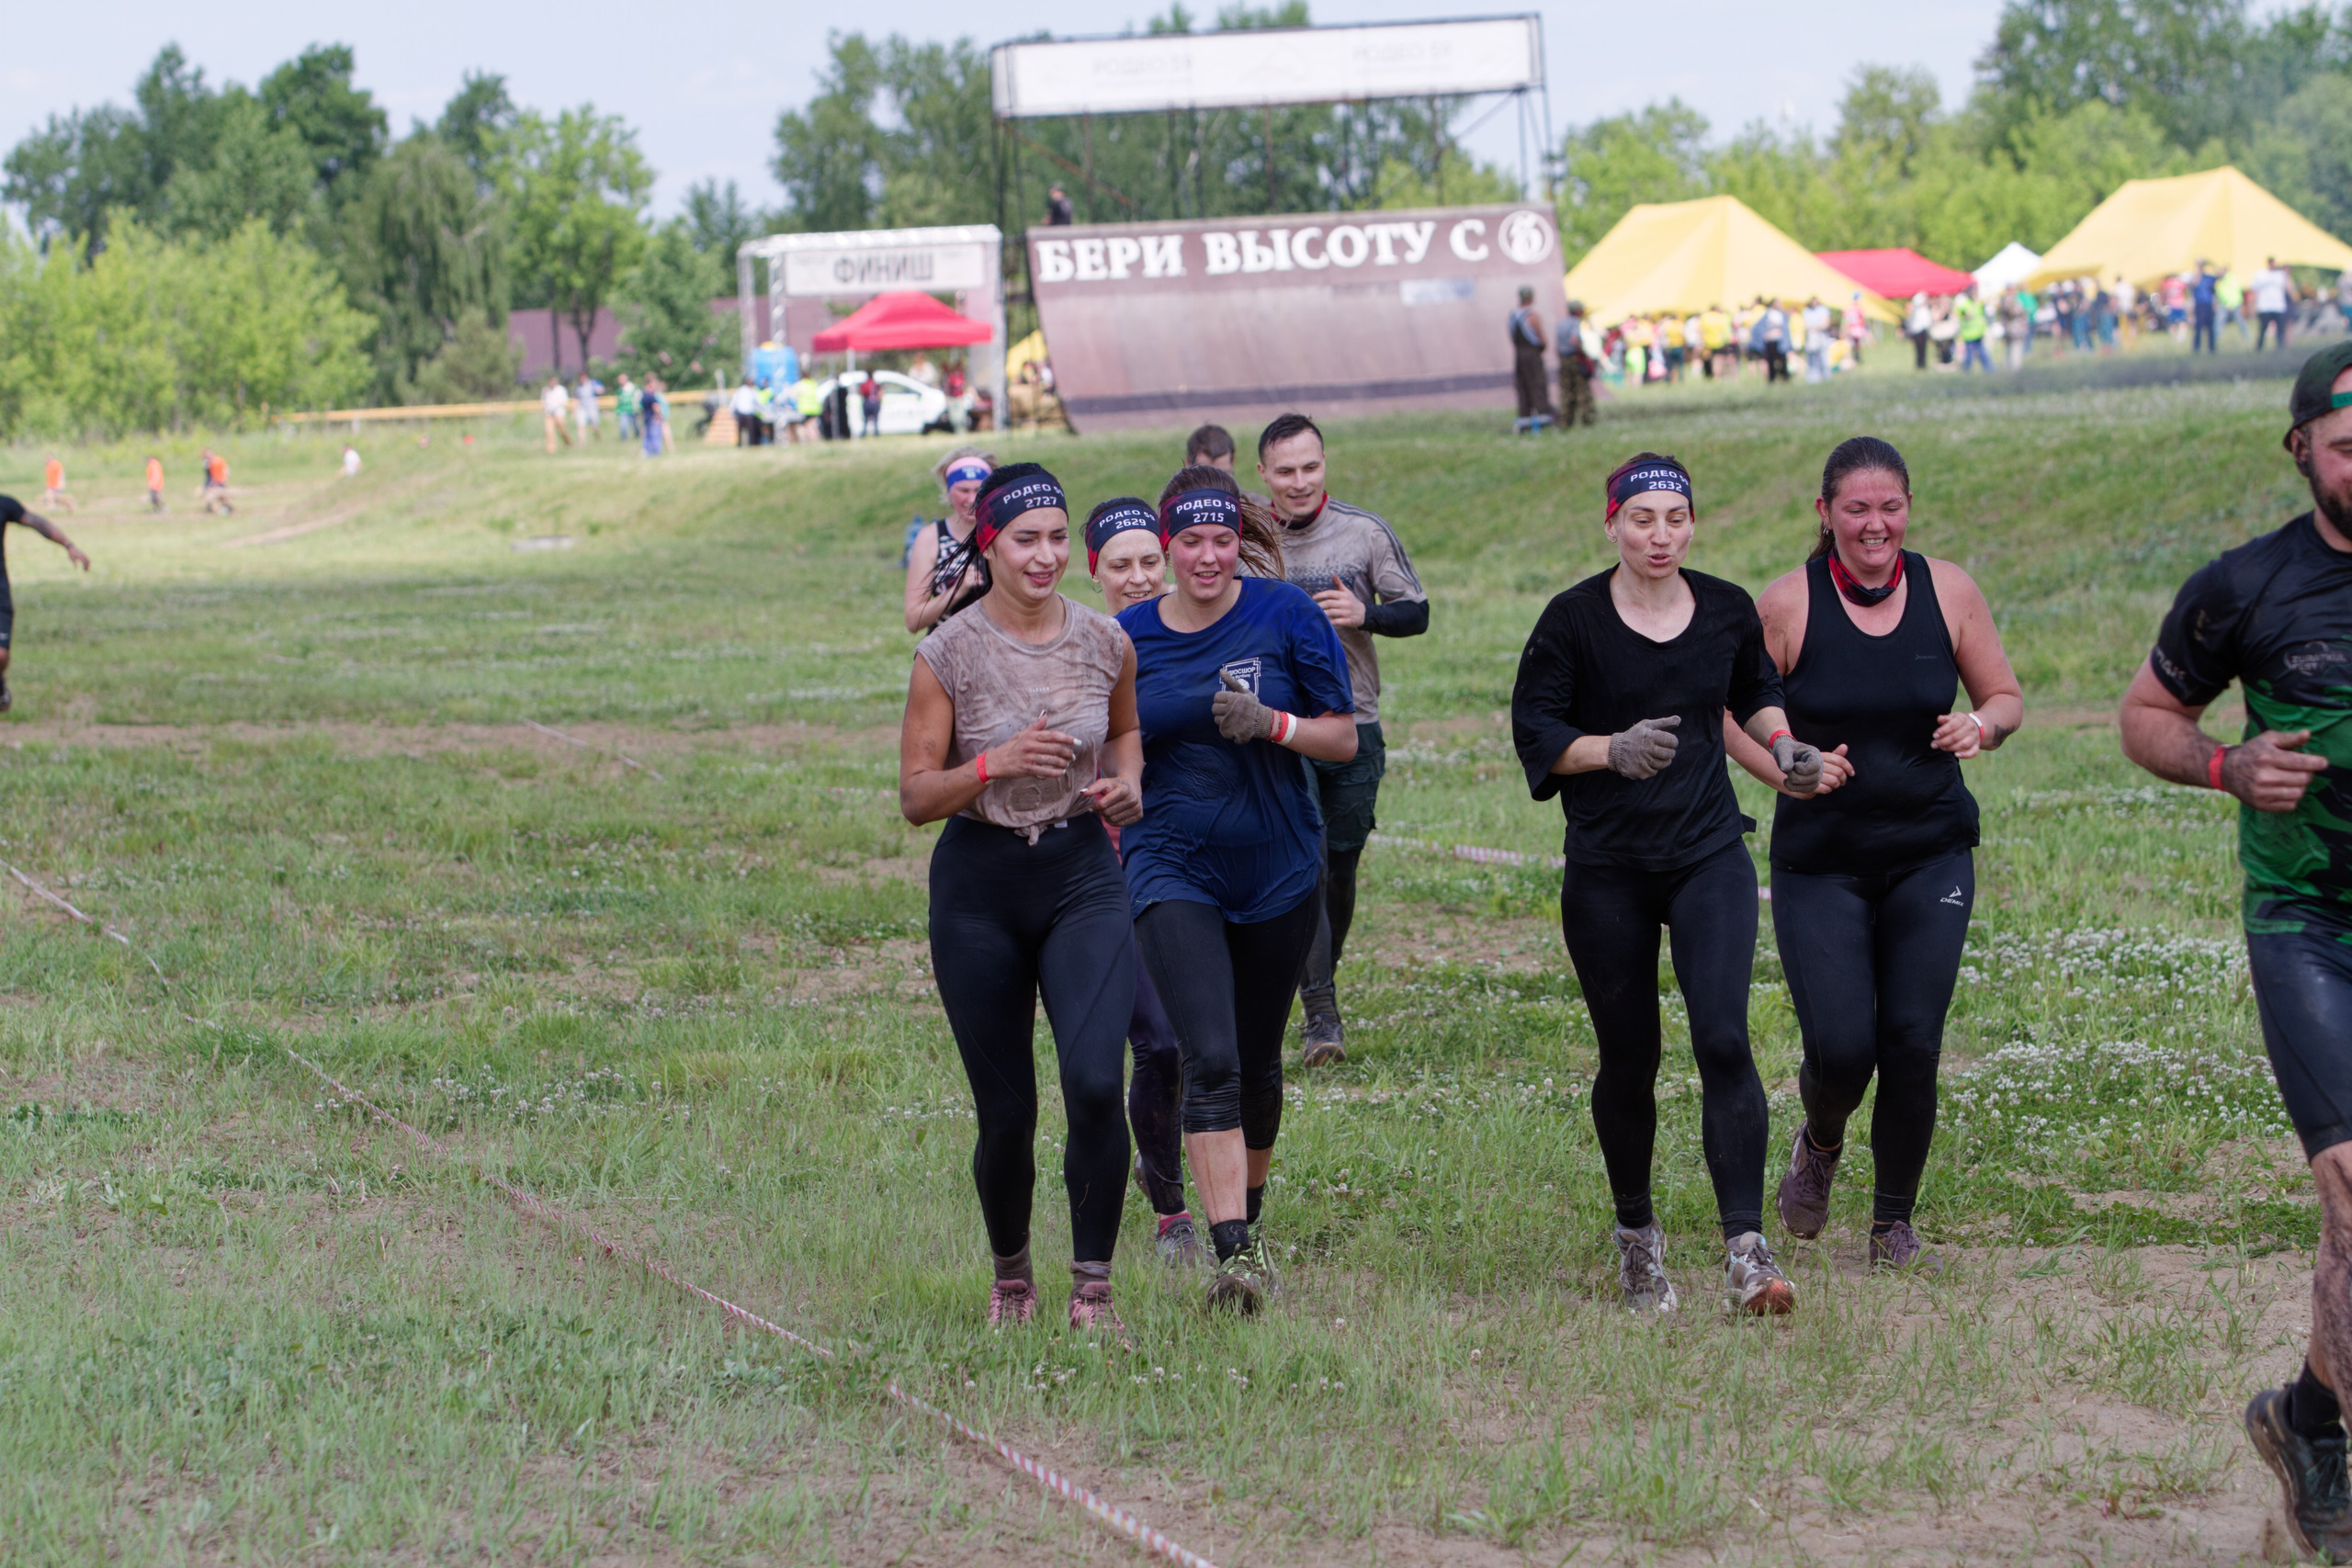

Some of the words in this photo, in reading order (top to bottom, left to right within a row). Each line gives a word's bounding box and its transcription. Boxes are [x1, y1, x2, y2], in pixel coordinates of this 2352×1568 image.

[1035, 233, 1184, 282] БЕРИ
[1200, 220, 1436, 275] ВЫСОТУ
[1448, 219, 1489, 263] С
[833, 252, 934, 284] ФИНИШ
[1631, 470, 1678, 482] РОДЕО
[1649, 481, 1682, 492] 2632
[1002, 483, 1052, 504] РОДЕО
[1024, 496, 1057, 509] 2727
[1176, 499, 1222, 514] РОДЕО
[1225, 501, 1236, 513] 59
[1099, 509, 1141, 528] РОДЕО
[1114, 517, 1147, 530] 2629
[1193, 512, 1225, 524] 2715
[1939, 897, 1964, 908] DEMIX
